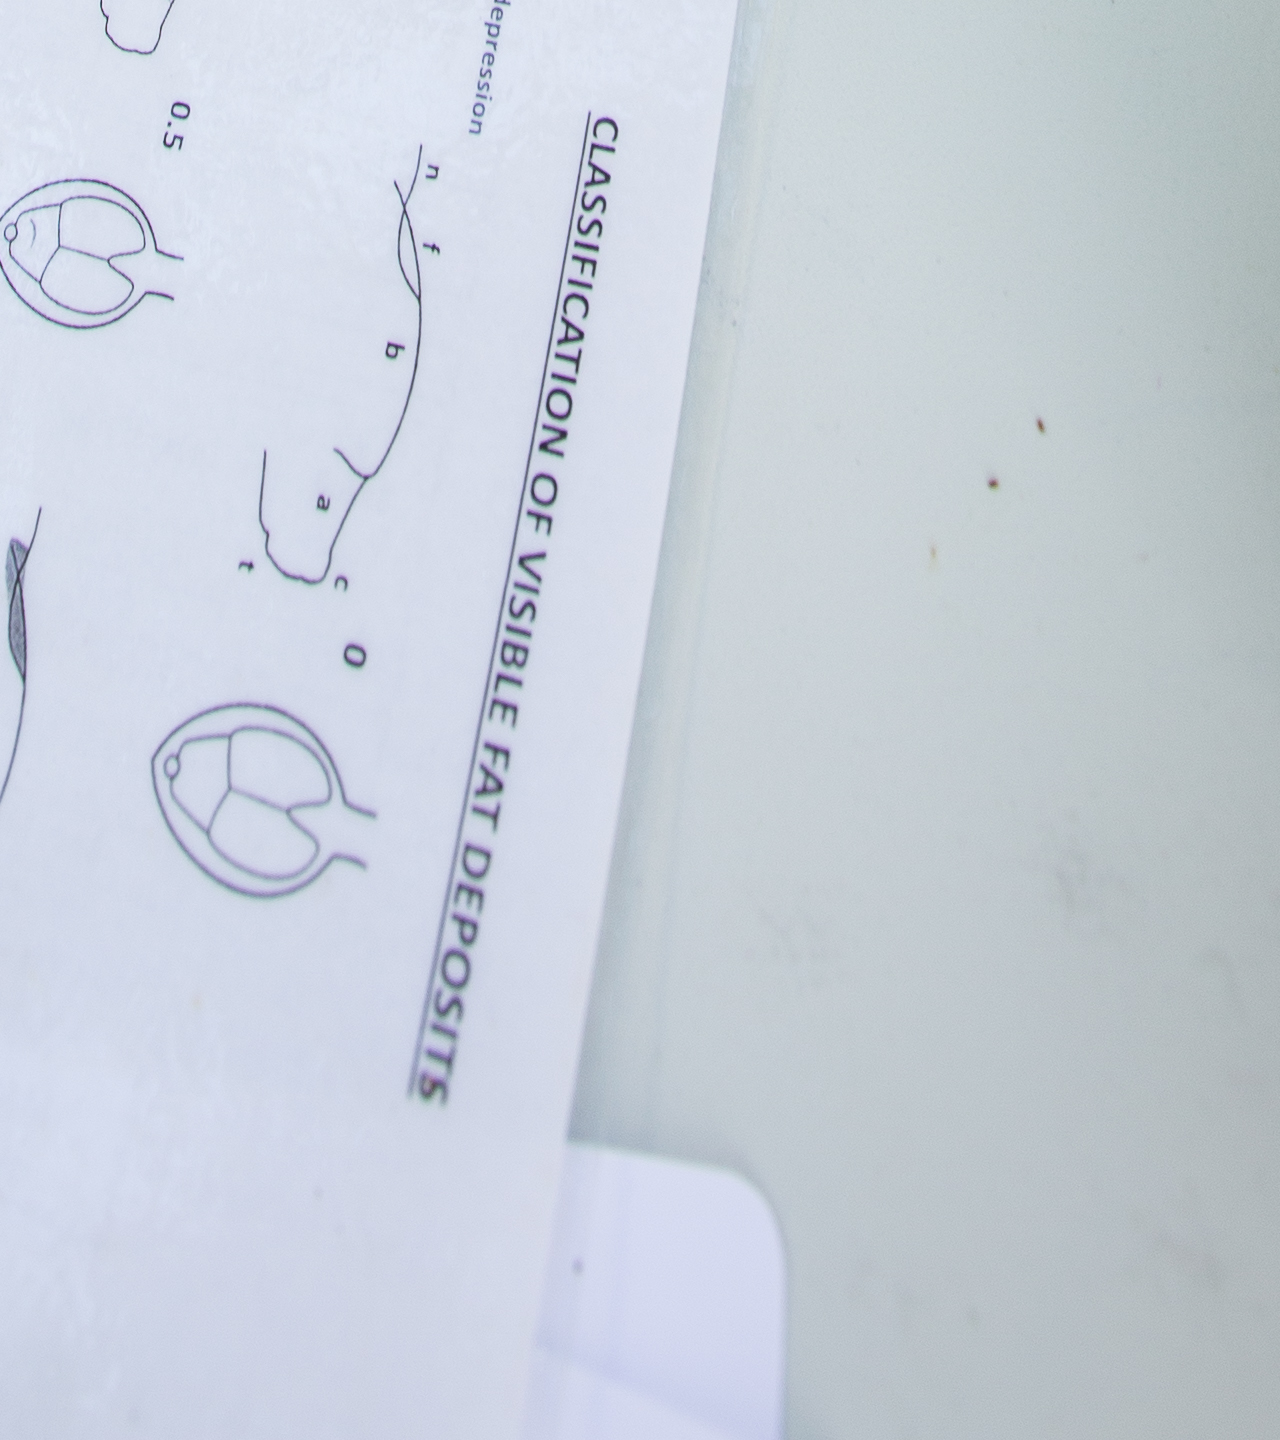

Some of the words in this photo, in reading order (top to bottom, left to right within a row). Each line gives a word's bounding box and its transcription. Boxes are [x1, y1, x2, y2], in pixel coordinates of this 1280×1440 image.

[162, 101, 191, 151] 0.5
[425, 164, 440, 180] n
[422, 242, 441, 255] f
[540, 115, 619, 459] CLASSIFICATION
[384, 341, 406, 360] b
[316, 494, 331, 512] a
[523, 471, 562, 539] OF
[238, 561, 255, 572] t
[333, 574, 349, 591] c
[488, 554, 547, 730] VISIBLE
[472, 741, 513, 838] FAT
[416, 842, 496, 1107] DEPOSITS
